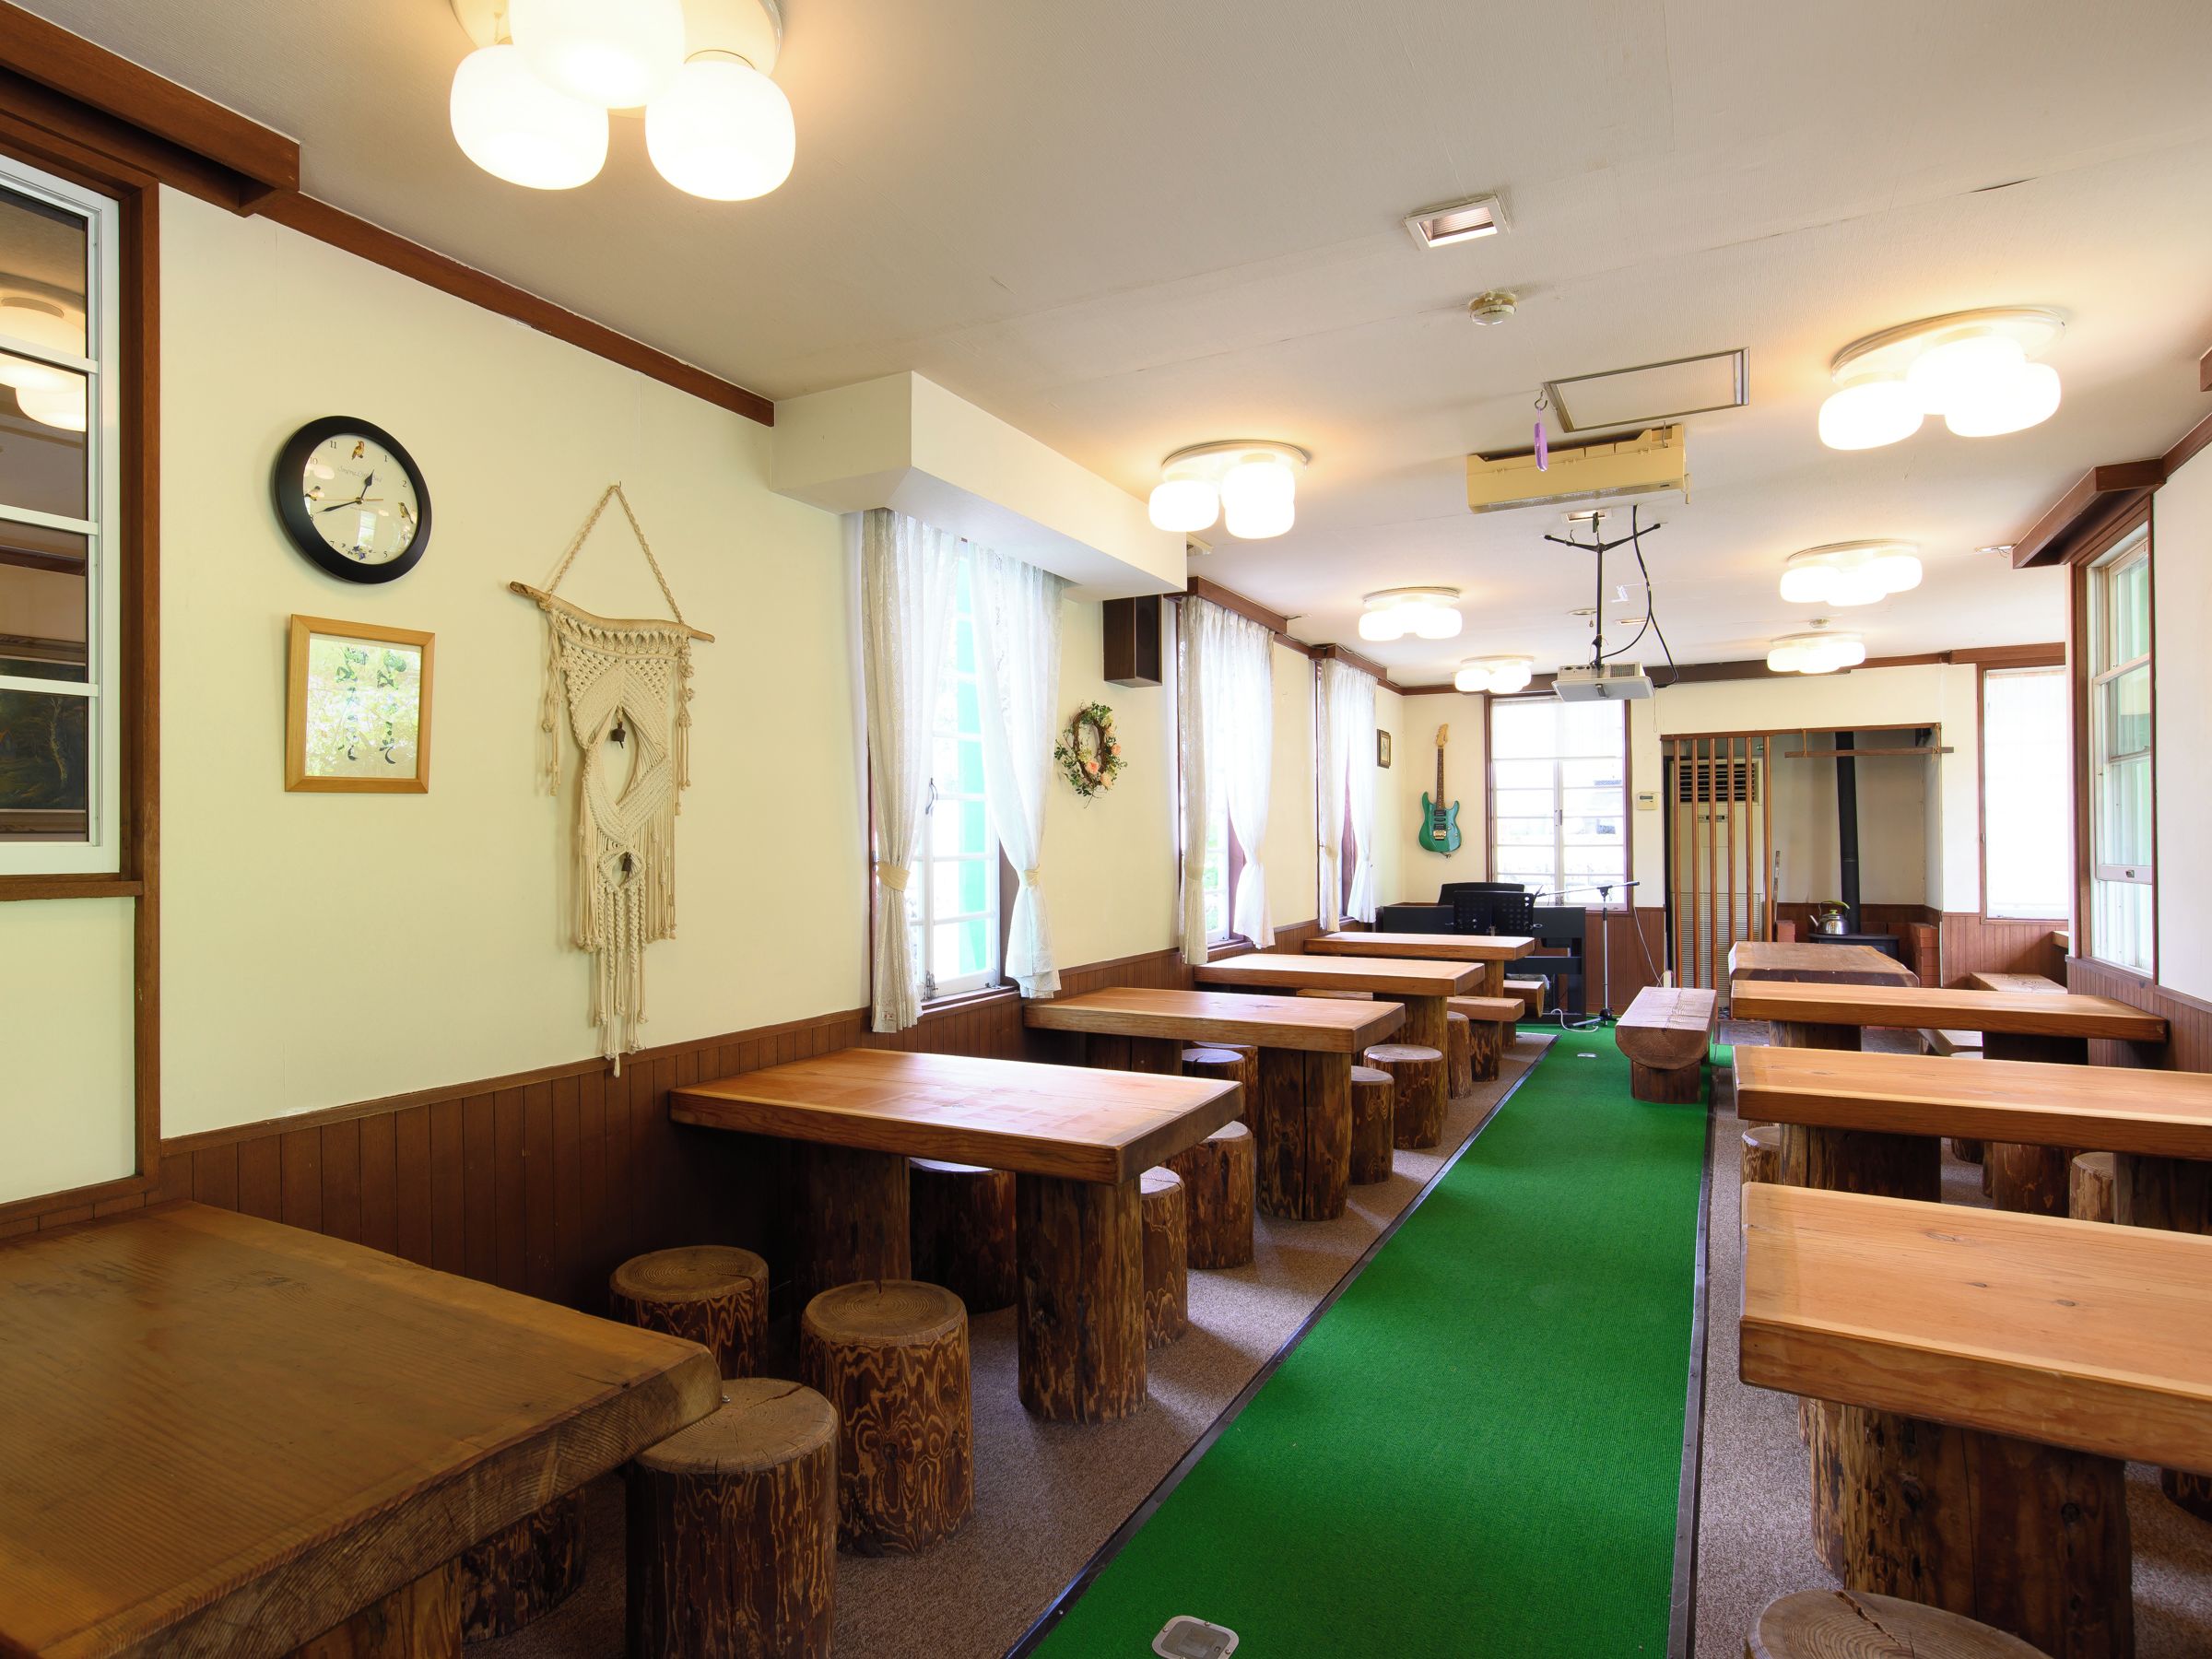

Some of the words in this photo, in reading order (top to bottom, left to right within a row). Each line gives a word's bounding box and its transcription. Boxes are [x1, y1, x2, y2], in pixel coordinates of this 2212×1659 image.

[330, 440, 337, 449] 11
[310, 456, 318, 465] 10
[402, 479, 407, 488] 2
